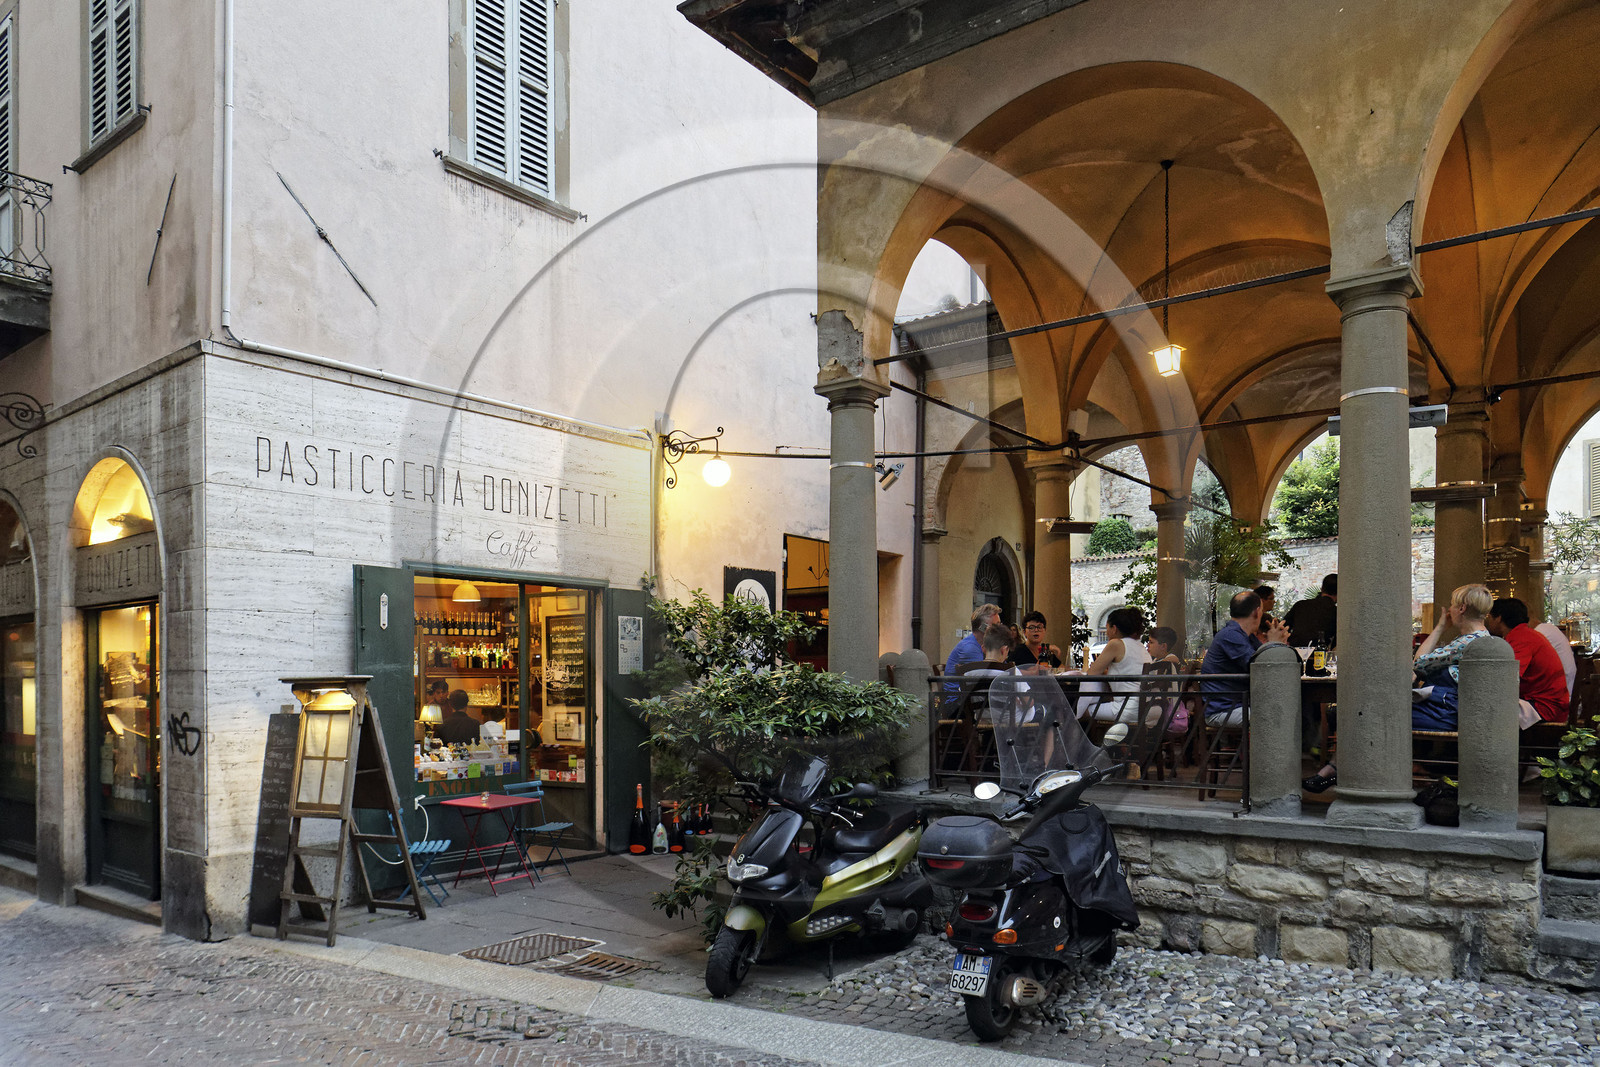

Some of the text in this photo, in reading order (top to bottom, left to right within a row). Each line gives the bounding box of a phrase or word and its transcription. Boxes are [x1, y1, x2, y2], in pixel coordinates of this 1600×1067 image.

[256, 436, 607, 528] PASTICCERIA DONIZETTI
[86, 543, 158, 593] DONIZETTI
[428, 777, 503, 797] ENOT
[962, 955, 977, 971] AM
[951, 973, 986, 992] 68297
